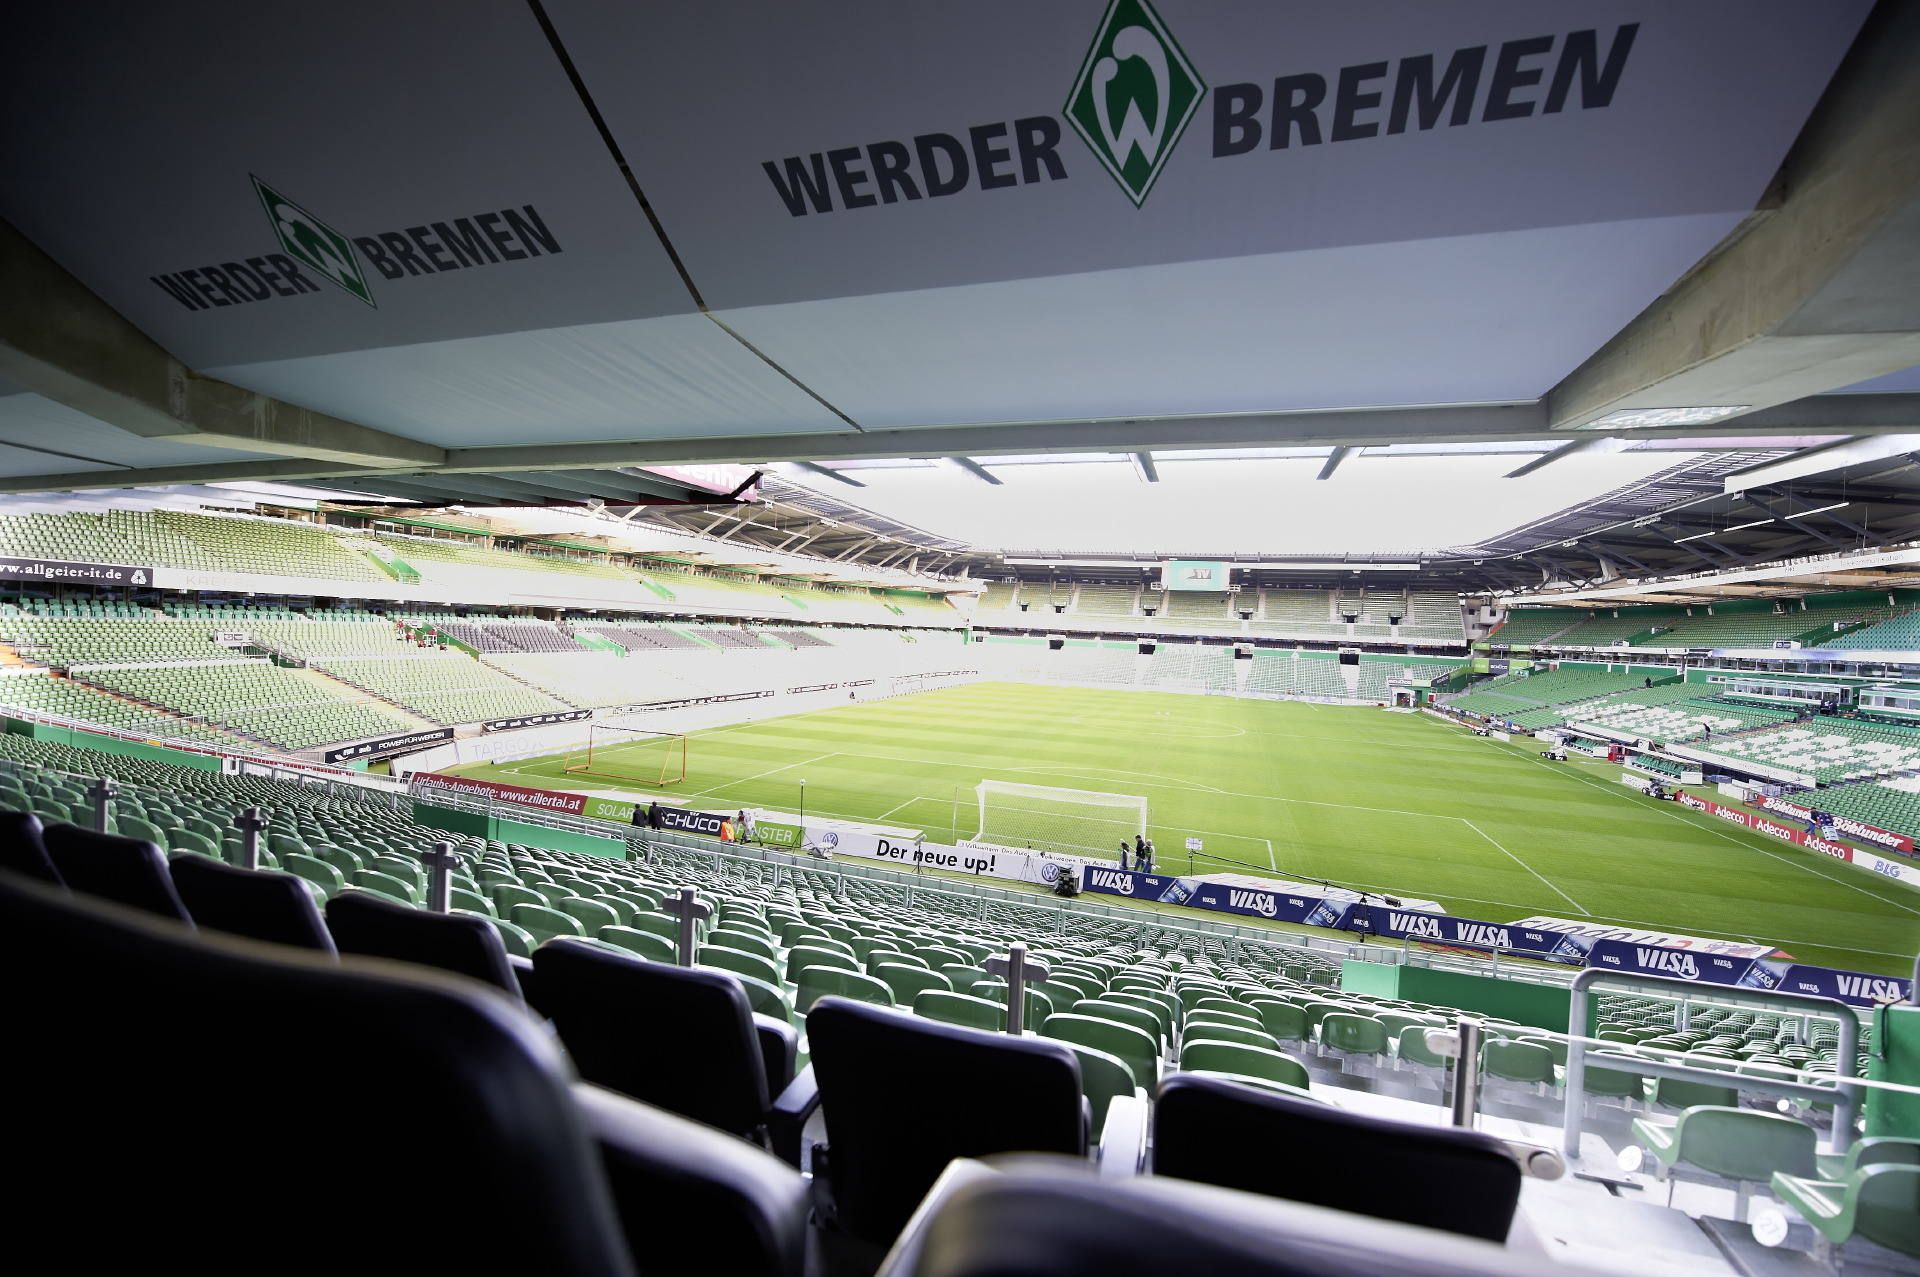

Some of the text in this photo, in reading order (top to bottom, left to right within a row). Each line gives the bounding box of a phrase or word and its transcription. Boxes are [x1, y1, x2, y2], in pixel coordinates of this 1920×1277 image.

[763, 115, 1069, 218] WERDER
[1212, 22, 1641, 158] BREMEN
[150, 254, 321, 311] WERDER
[353, 205, 564, 280] BREMEN
[0, 563, 122, 580] ww.allgeier-it.de
[500, 790, 581, 810] www.zillertal.at
[597, 803, 634, 820] SOLAR
[1715, 805, 1745, 825] Adecco
[737, 821, 793, 843] FNSTER
[1755, 819, 1791, 840] Adecco
[1832, 815, 1904, 849] Böklunder
[877, 839, 996, 875] Der neue up!
[1803, 834, 1845, 859] Adecco
[1873, 859, 1900, 878] BLG
[1091, 870, 1134, 894] VILSA
[1229, 889, 1278, 917] VILSA
[1389, 912, 1443, 939] VILSA
[1457, 922, 1513, 952] VILSA
[1636, 947, 1700, 980] VILSA
[1713, 958, 1733, 969] VILSA
[1798, 982, 1820, 994] VILSA
[1836, 974, 1905, 1001] VILSA
